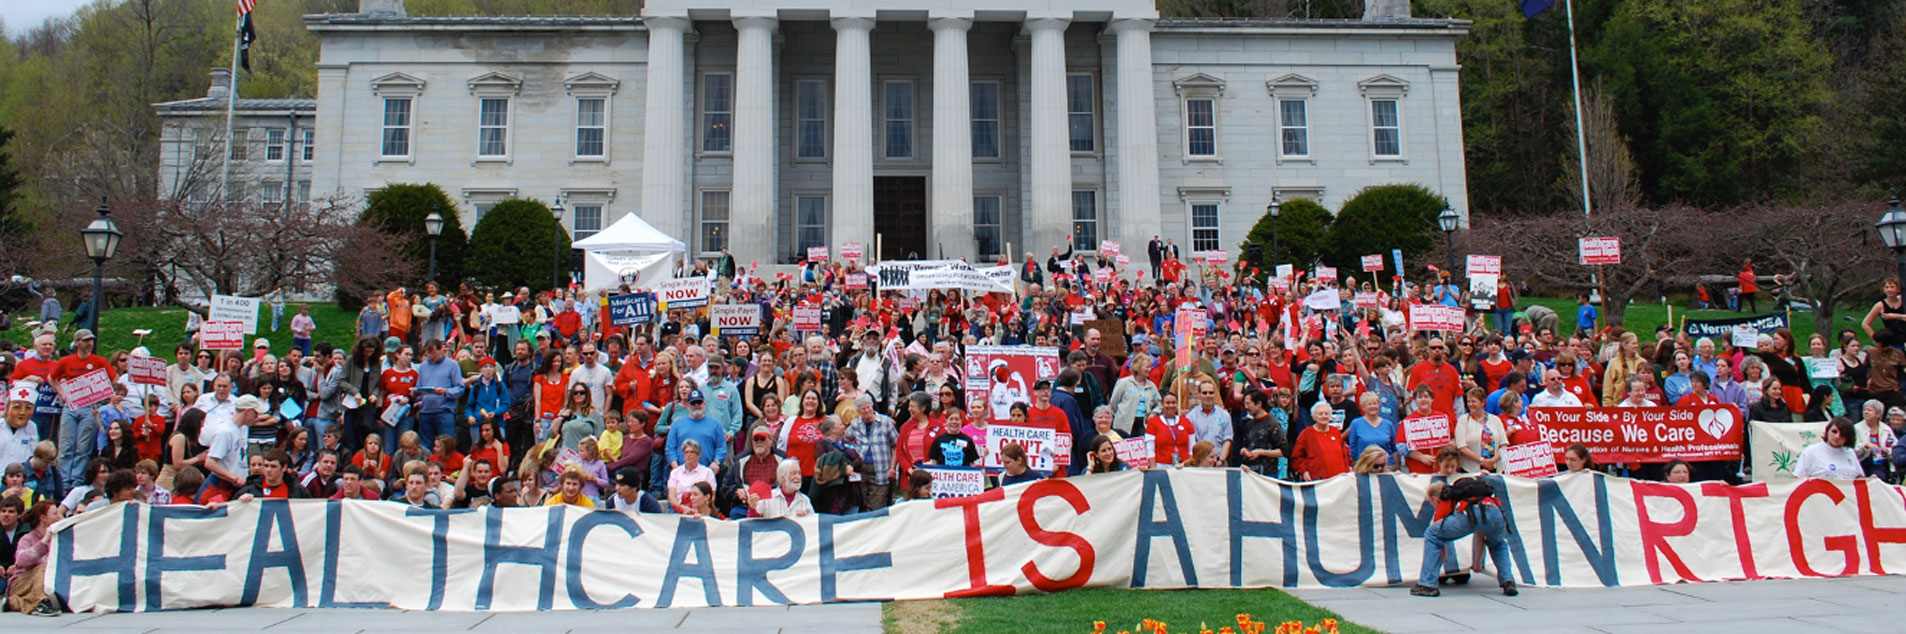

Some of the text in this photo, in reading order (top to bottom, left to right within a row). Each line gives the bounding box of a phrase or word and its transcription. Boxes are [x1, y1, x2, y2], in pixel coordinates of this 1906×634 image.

[666, 289, 698, 299] NOW
[611, 297, 646, 307] Medicare
[625, 301, 649, 317] All
[719, 316, 752, 326] NOW
[1700, 316, 1784, 335] Vermt-NEA
[1535, 408, 1694, 424] On Your Side By Your Side
[992, 428, 1051, 441] HEALTH CARE
[1540, 423, 1696, 444] Because We Care
[956, 473, 980, 482] CARE
[940, 482, 980, 492] AMERICA
[54, 470, 1906, 612] HEALTHCARE IS A HUMAN RIGH
